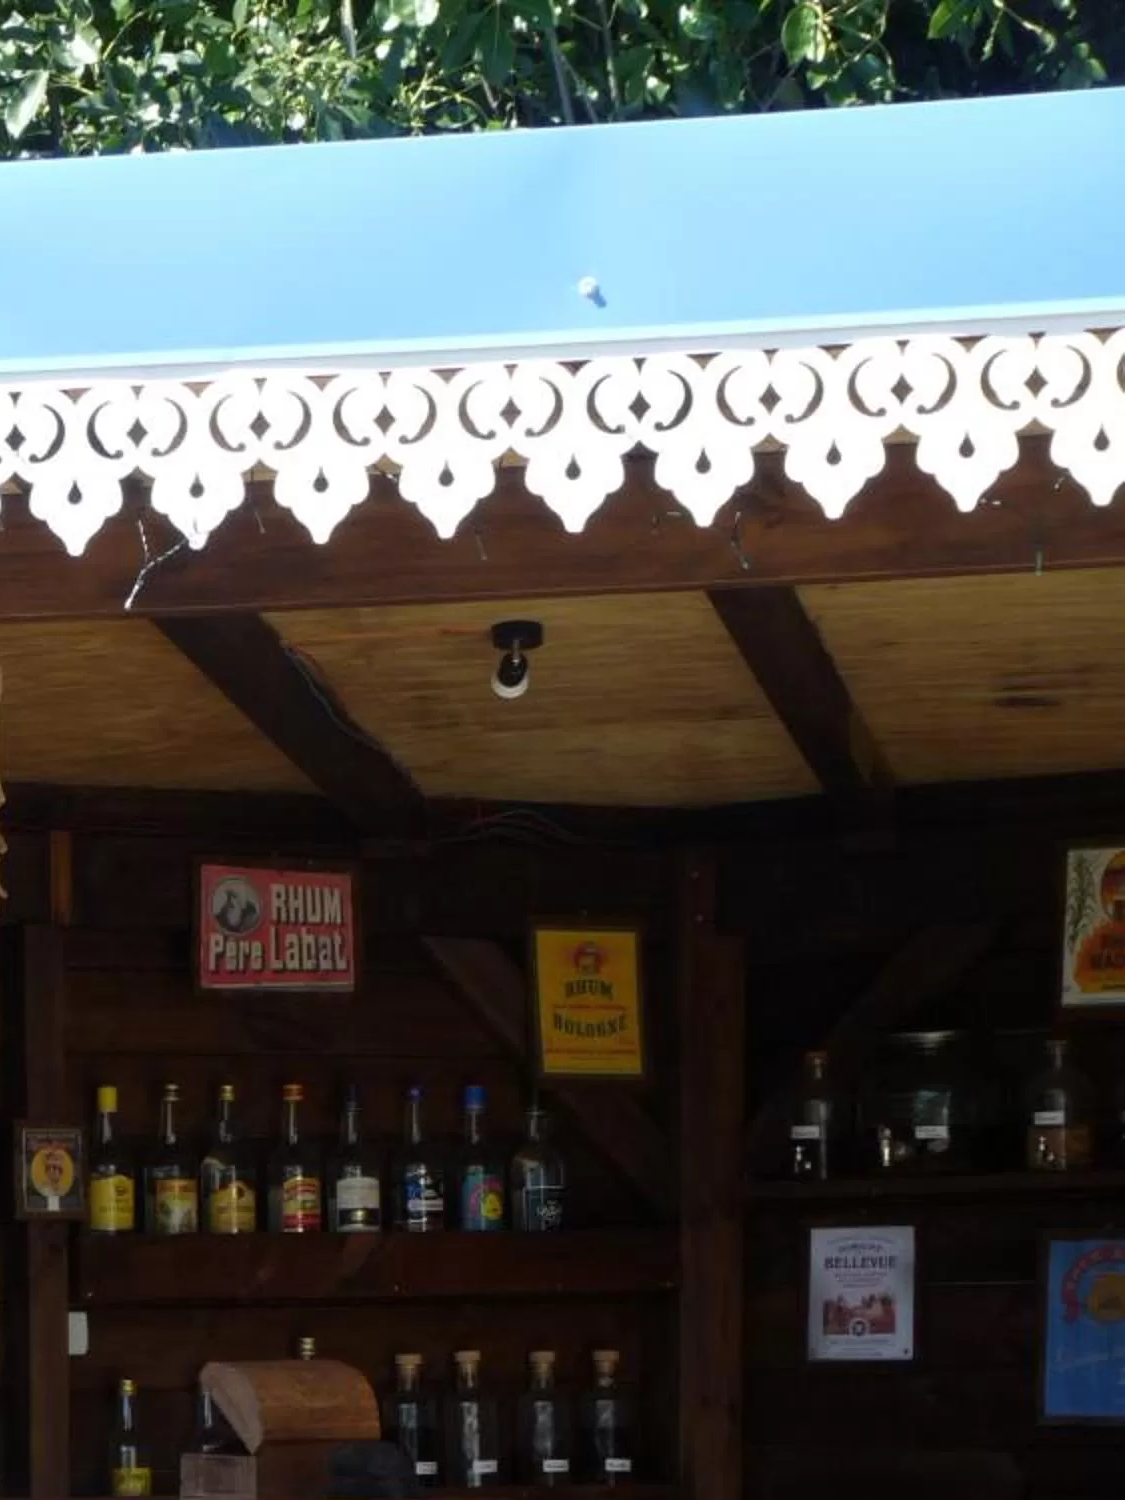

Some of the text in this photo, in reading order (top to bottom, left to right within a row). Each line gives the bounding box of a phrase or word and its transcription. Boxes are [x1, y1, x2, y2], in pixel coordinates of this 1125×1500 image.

[269, 882, 344, 924] RHUM
[269, 925, 348, 972] Labat
[565, 979, 613, 1001] RHUM
[824, 1255, 897, 1269] BELLEVUE
